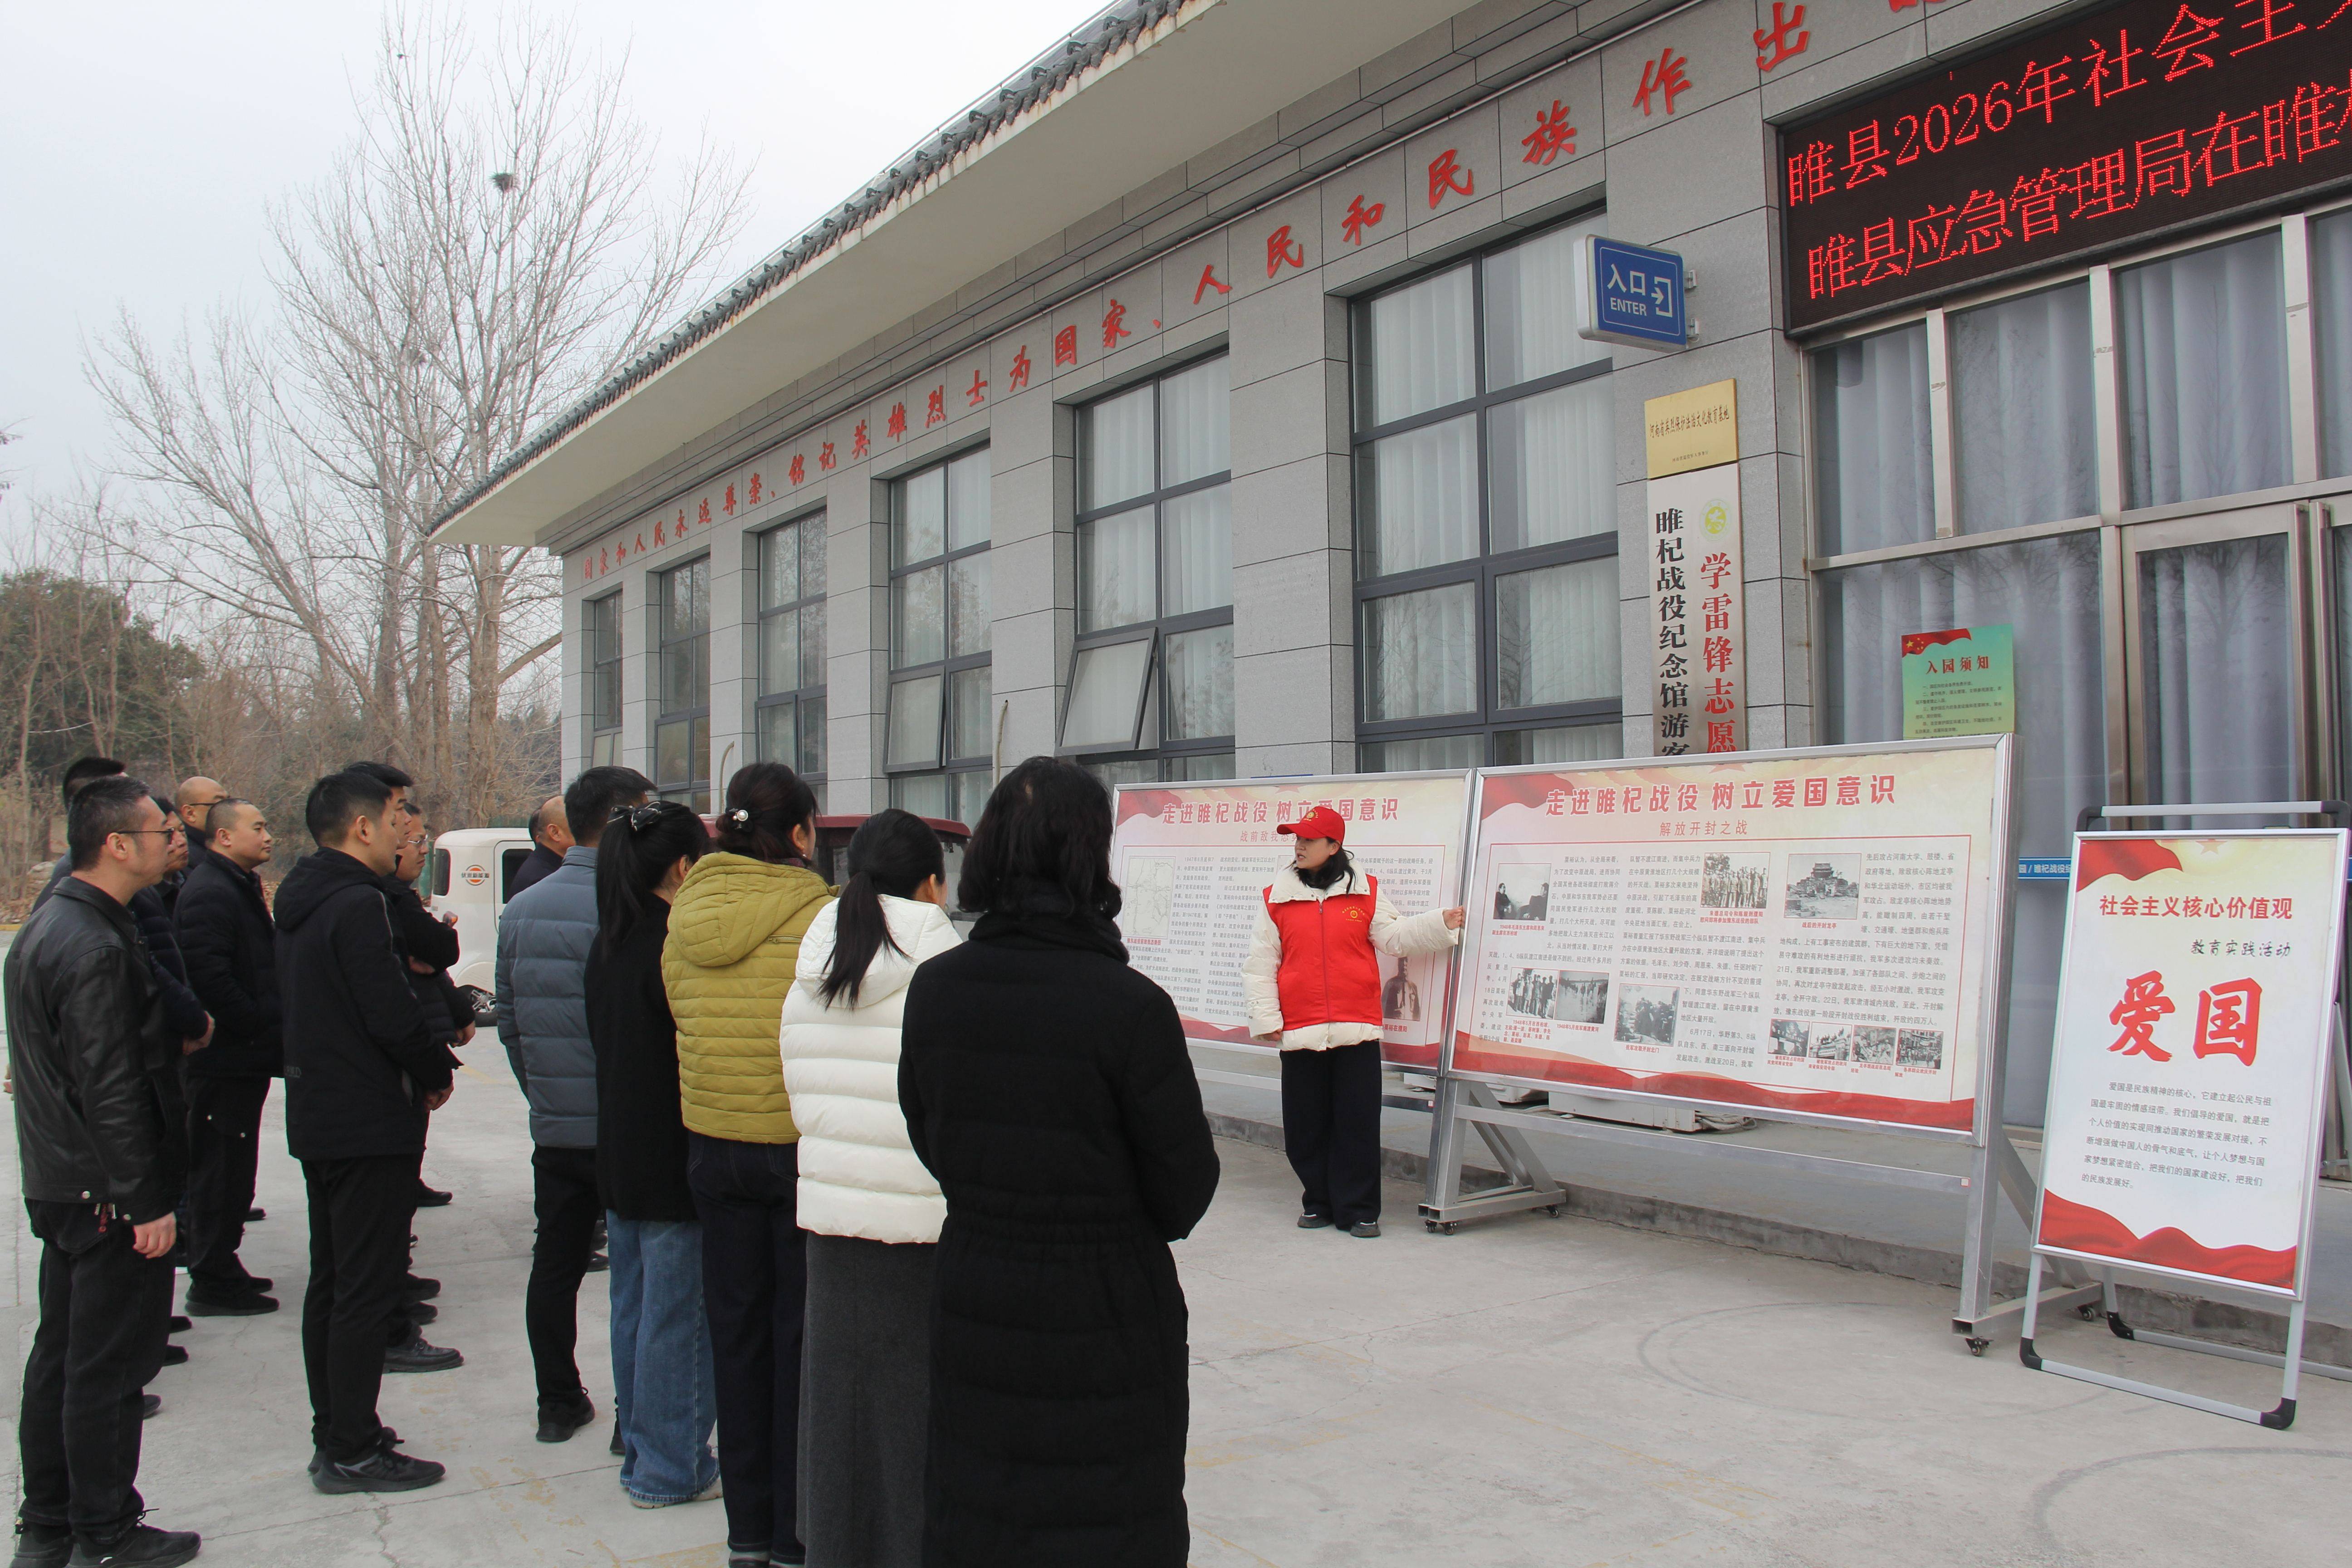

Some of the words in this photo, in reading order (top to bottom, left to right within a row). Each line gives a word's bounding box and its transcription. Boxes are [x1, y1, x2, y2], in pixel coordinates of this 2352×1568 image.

[1788, 0, 2352, 207] 睢县2026年社会主
[1808, 68, 2352, 299] 睢县应急管理局在睢
[584, 0, 1946, 579] 国家和人民永远尊崇、铭记英雄烈士为国家、人民和民族作出
[1607, 264, 1646, 296] 入口
[1610, 297, 1647, 316] ENTER
[1700, 552, 1737, 754] 学雷锋志愿
[1926, 655, 1989, 675] 入园须知
[1545, 784, 1699, 817] 走进睢杞战役
[1711, 774, 1896, 812] 树立爱国意识
[1162, 801, 1268, 824] 走进睢杞战役
[1659, 819, 1748, 837] 解放开封之战
[1866, 853, 1955, 861] 先后攻占河南大学、鼓楼、省
[1865, 867, 1954, 876] 政府等地，除敌核心阵地龙亭
[1863, 897, 1951, 905] 军攻占。敌龙亭核心阵地地势
[2099, 895, 2293, 920] 社会主义核心价值观
[1861, 926, 1949, 935] 壕、交通壕、地堡群和炮兵阵
[2190, 939, 2291, 958] 教育实践活动
[2106, 970, 2263, 1067] 爱国
[2108, 1082, 2271, 1106] 爱国是民族精神的核心，它建立起公民与祖
[2090, 1098, 2269, 1126] 国最牢固的情感纽带。我们倡导的爱国，就是把
[2088, 1117, 2267, 1146] 个人价值的实现同推动国家的繁荣发展对接，不
[2086, 1136, 2264, 1166] 断增强做中国人的骨气和底气，让个人梦想与国
[2082, 1173, 2133, 1189] 的民族发展好。
[2084, 1155, 2262, 1187] 家梦想紧密结合，把我们的国家建设好，把我们
